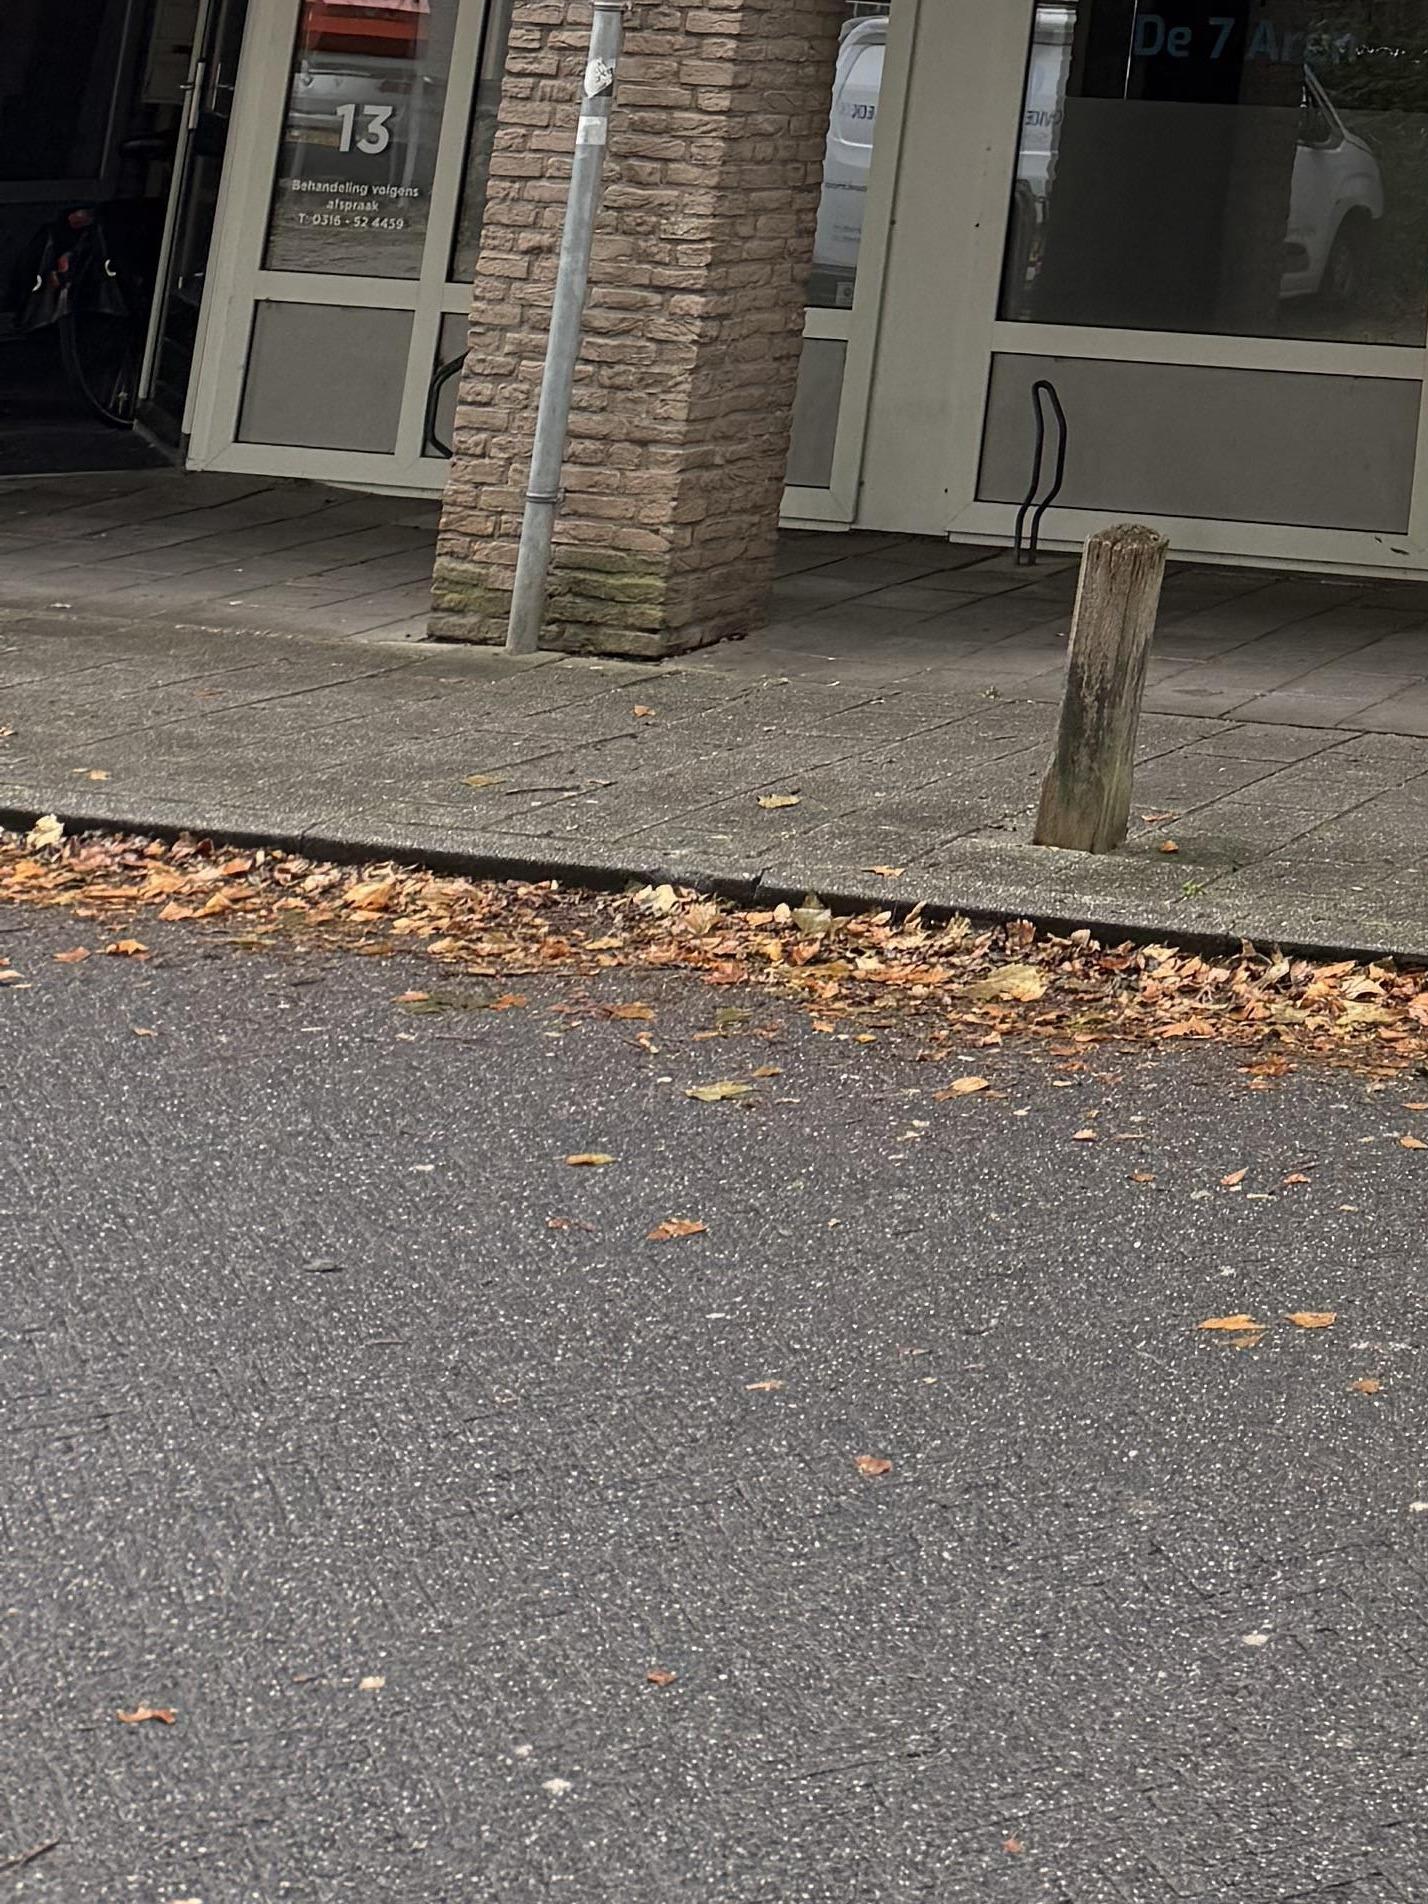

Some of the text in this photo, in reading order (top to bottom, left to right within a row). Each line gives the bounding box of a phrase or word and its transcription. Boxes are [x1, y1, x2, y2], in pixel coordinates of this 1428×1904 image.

[1135, 13, 1193, 59] De
[1208, 16, 1237, 60] 7
[336, 103, 393, 154] 13
[291, 179, 419, 198] Behandeling volgens
[326, 198, 379, 212] afspraak
[312, 213, 341, 224] 0316
